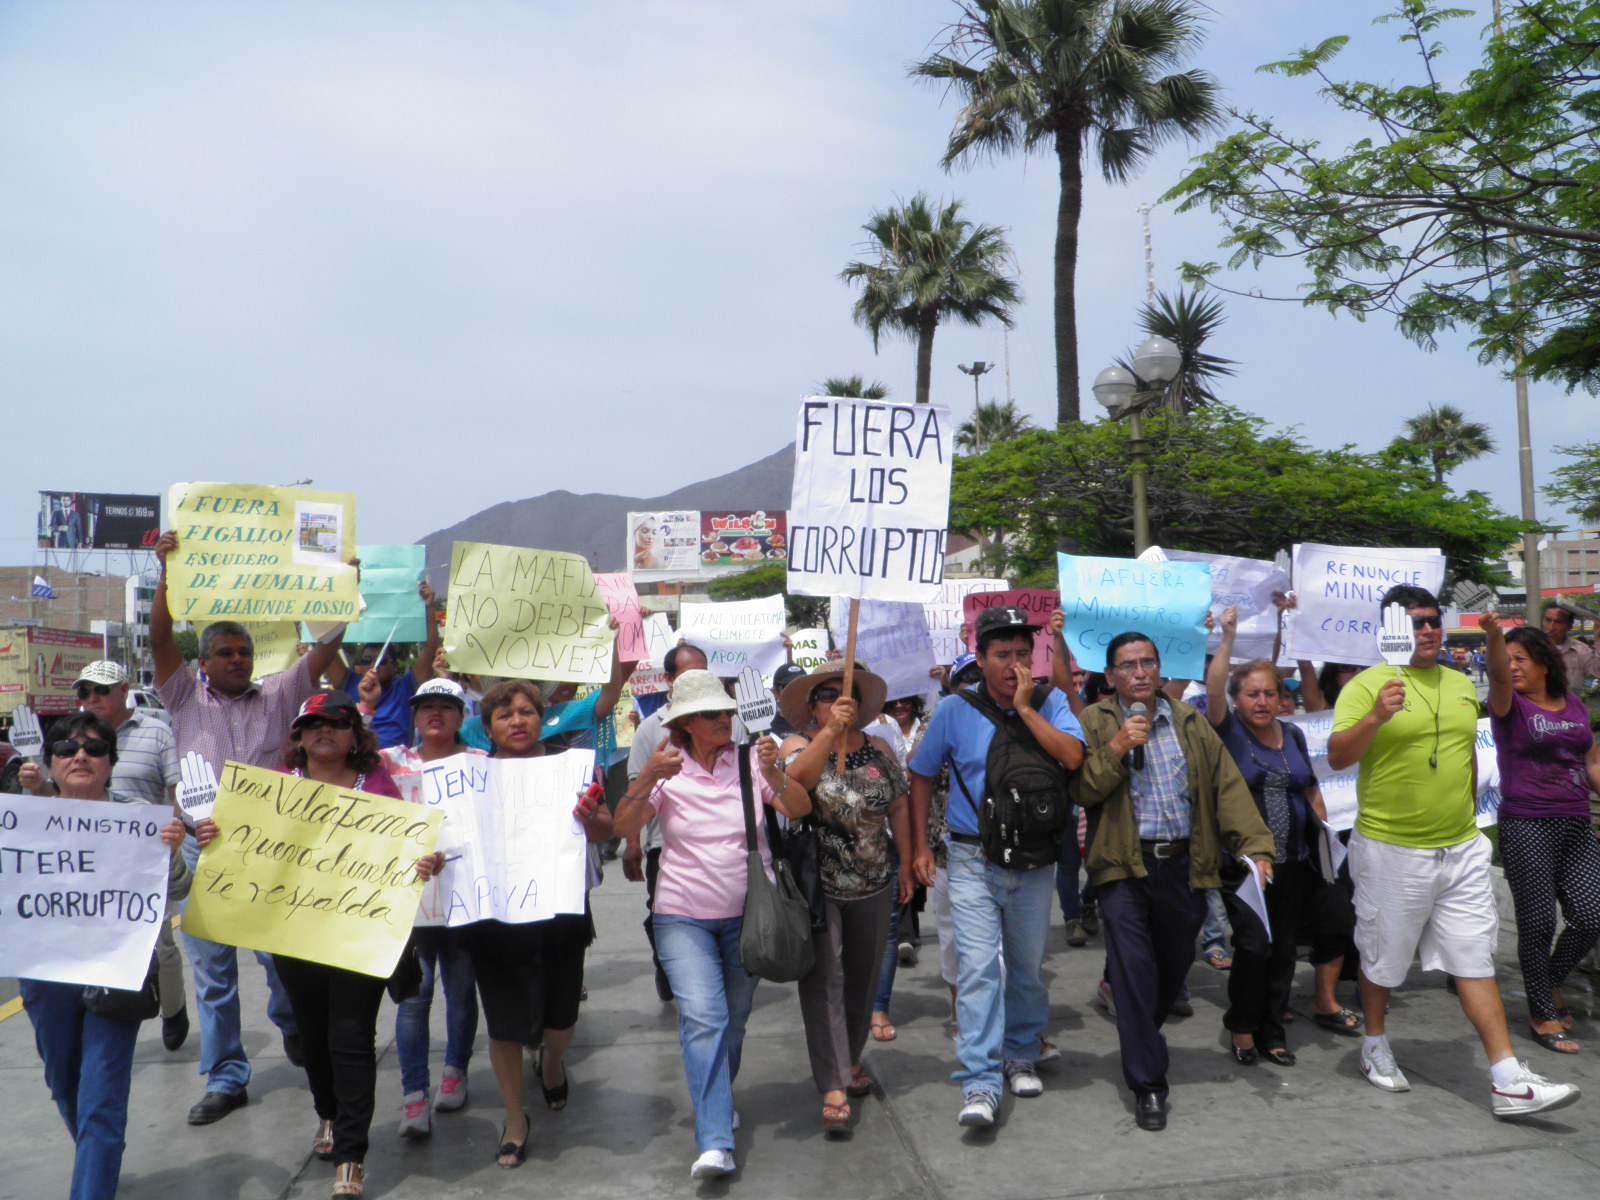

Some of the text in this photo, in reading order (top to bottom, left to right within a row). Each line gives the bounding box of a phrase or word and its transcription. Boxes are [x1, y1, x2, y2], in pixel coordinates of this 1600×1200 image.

[803, 402, 942, 464] FUERA
[850, 468, 908, 504] LOS
[184, 552, 279, 566] ESCUDERO
[453, 548, 494, 590] LA
[188, 573, 335, 592] DE HUMALA
[1325, 580, 1387, 602] MINIS
[181, 598, 354, 616] Y BELAUNDE LOSSIO
[1463, 591, 1491, 609] VIGILANDO
[453, 594, 605, 640] NO DEBE
[1006, 609, 1023, 624] L
[466, 632, 609, 675] VOLVER
[710, 649, 749, 665] APOYA
[741, 705, 774, 722] VIGILANDO
[746, 698, 772, 708] ESTAMOS
[182, 786, 198, 795] ALTO
[423, 765, 488, 806] JENY
[46, 816, 158, 838] MINISTRO
[0, 847, 96, 874] TERE
[18, 889, 161, 923] CORRUPTOS
[249, 881, 393, 925] respalda
[447, 879, 538, 925] APOYA
